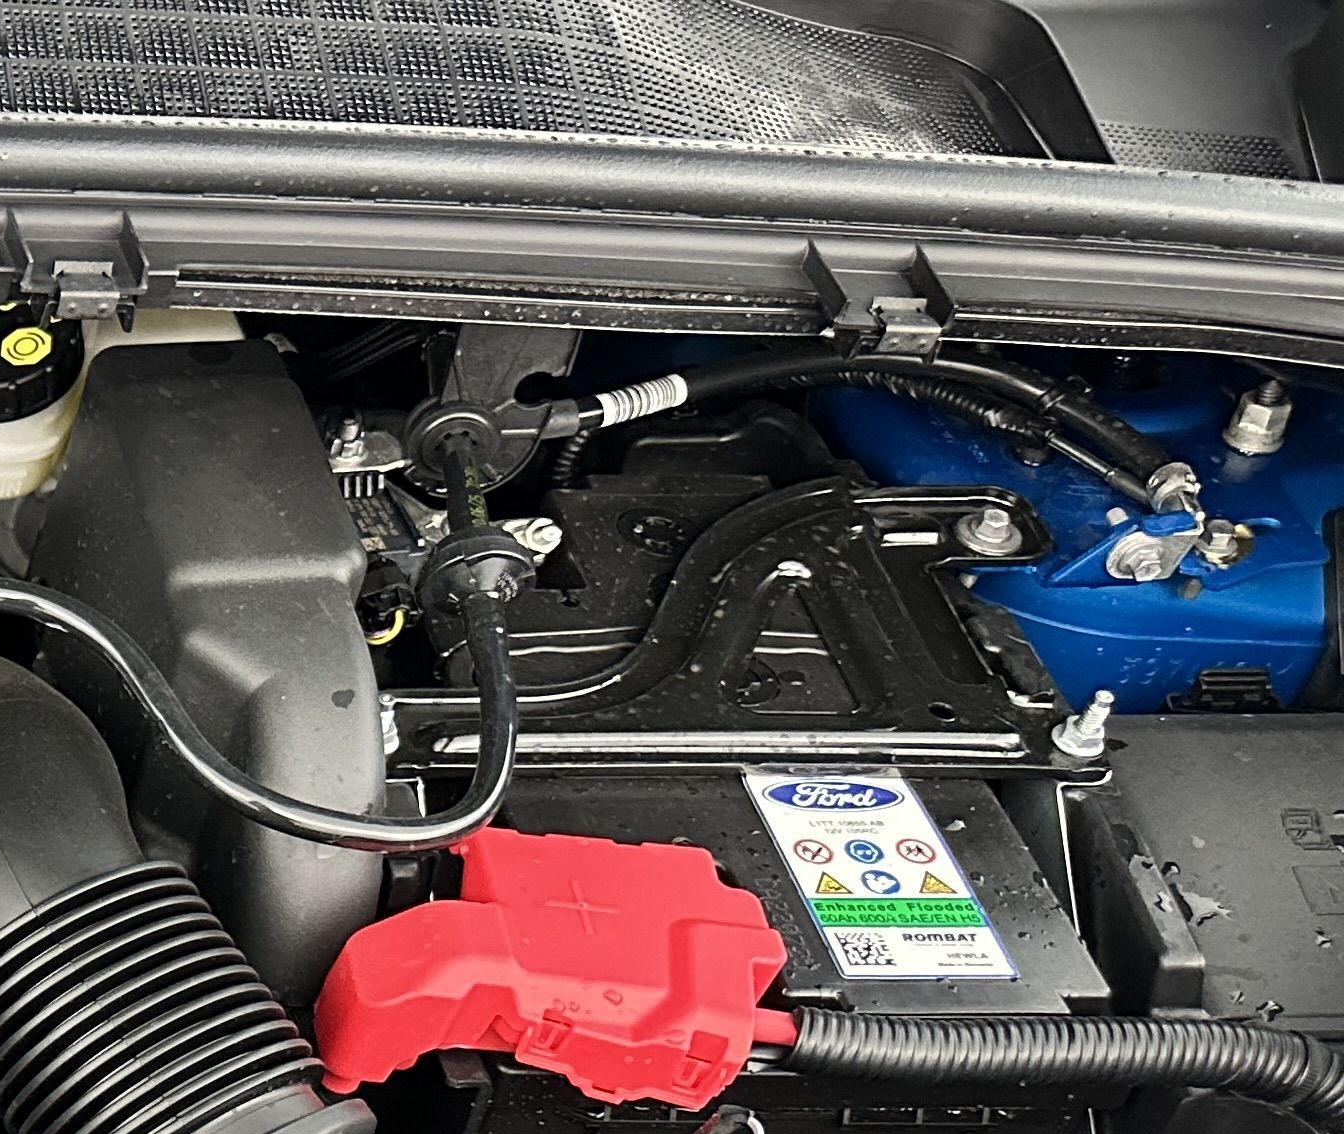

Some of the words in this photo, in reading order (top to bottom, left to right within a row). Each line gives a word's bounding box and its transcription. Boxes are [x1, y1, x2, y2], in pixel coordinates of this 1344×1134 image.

[795, 782, 876, 807] Ford
[814, 902, 897, 912] Enhanced
[906, 902, 975, 912] Flooded
[897, 913, 958, 924] SAE/EN
